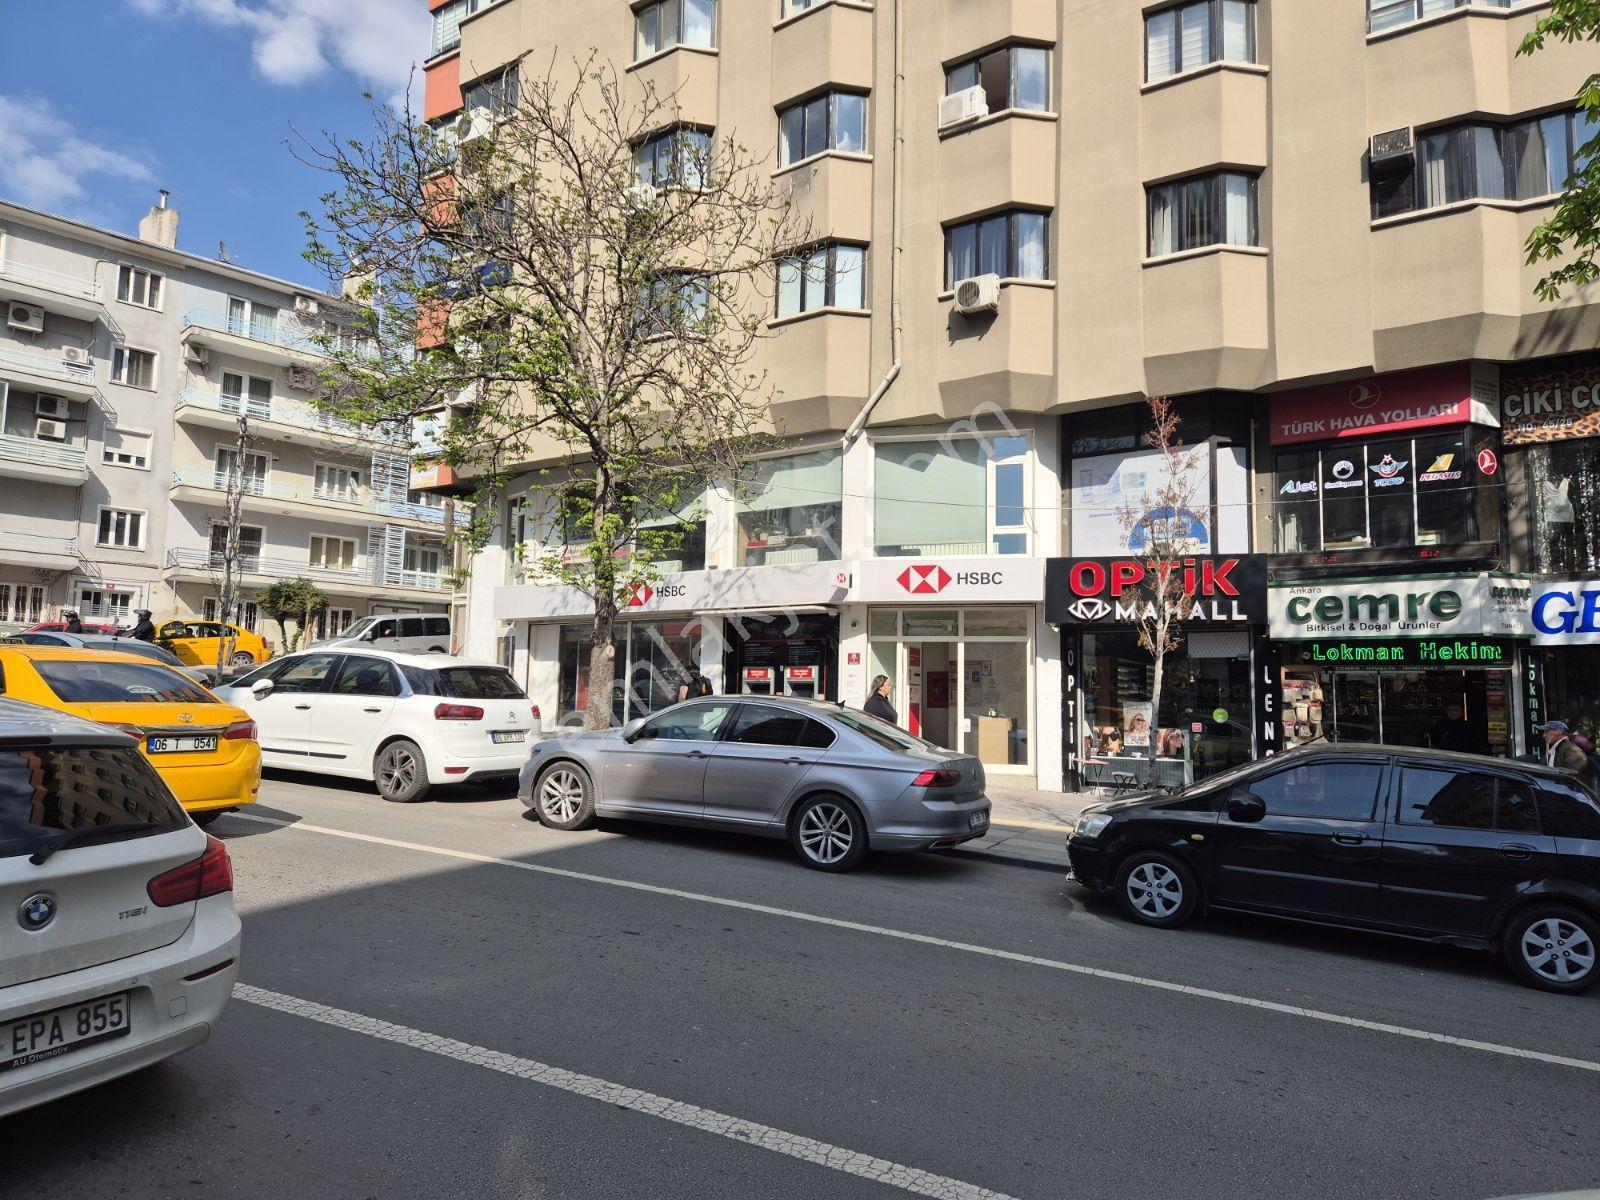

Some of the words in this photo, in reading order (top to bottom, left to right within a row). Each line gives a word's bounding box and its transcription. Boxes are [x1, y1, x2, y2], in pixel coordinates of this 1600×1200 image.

[1282, 419, 1326, 436] TÜRK
[1330, 413, 1376, 430] HAVA
[1380, 401, 1459, 423] YOLLARI
[1419, 471, 1462, 482] PEGASUS
[956, 572, 1003, 585] HSBC
[656, 585, 687, 598] HSBC
[1290, 586, 1322, 595] Ankara
[1287, 590, 1463, 625] cemre
[1306, 622, 1345, 632] Bitkisel
[1348, 622, 1356, 631] &
[1359, 620, 1391, 632] Doğal
[1313, 644, 1404, 661] Lokman
[1420, 642, 1502, 660] Hekim
[154, 739, 168, 751] 06
[175, 739, 181, 750] T
[193, 738, 216, 749] 0541
[12, 1015, 64, 1055] EPA
[77, 999, 123, 1036] 855
[12, 1057, 27, 1068] AU
[28, 1046, 69, 1063] Otomotiv
